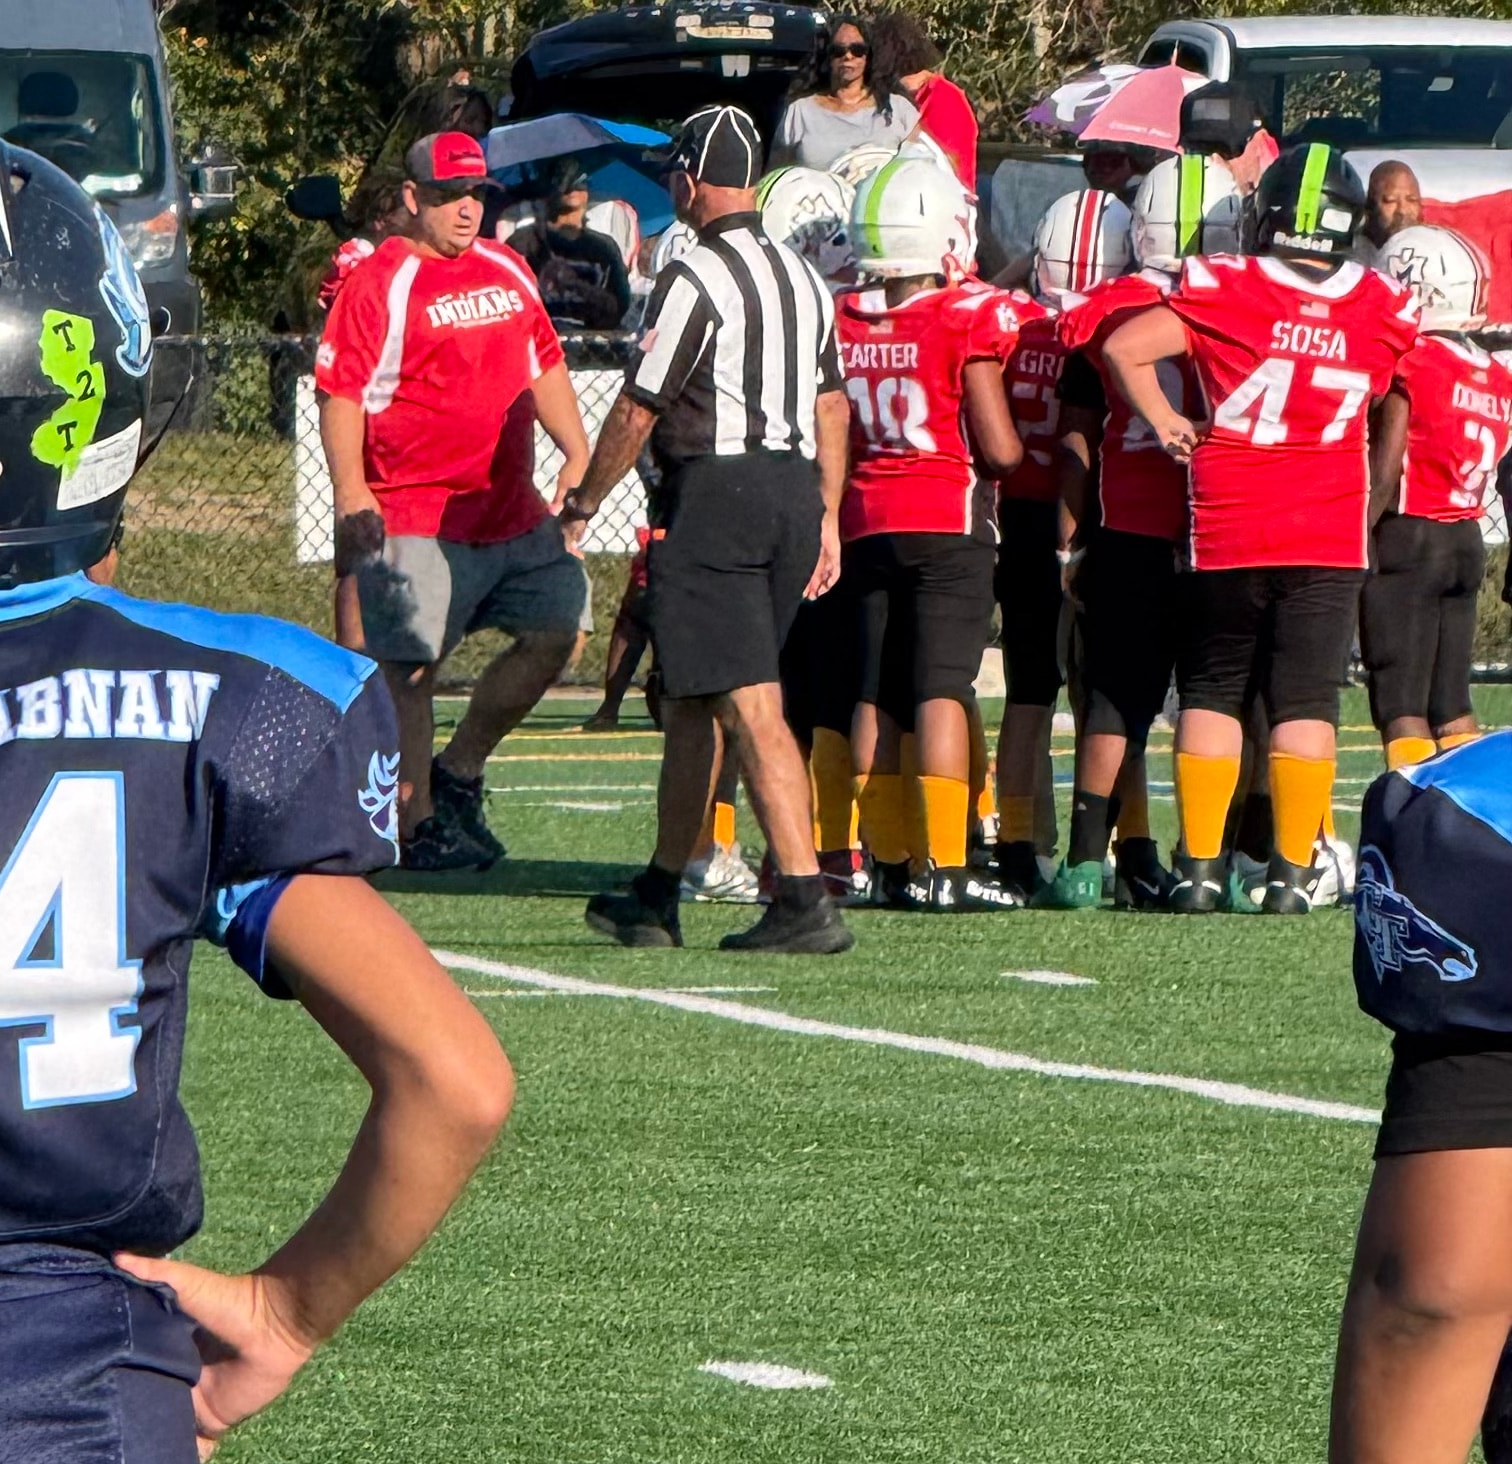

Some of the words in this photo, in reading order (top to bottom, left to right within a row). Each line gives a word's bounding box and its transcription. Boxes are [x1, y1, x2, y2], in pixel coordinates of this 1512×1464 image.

[426, 289, 524, 329] INDIANS
[1270, 320, 1347, 361] SOSA
[1214, 357, 1371, 446] 47
